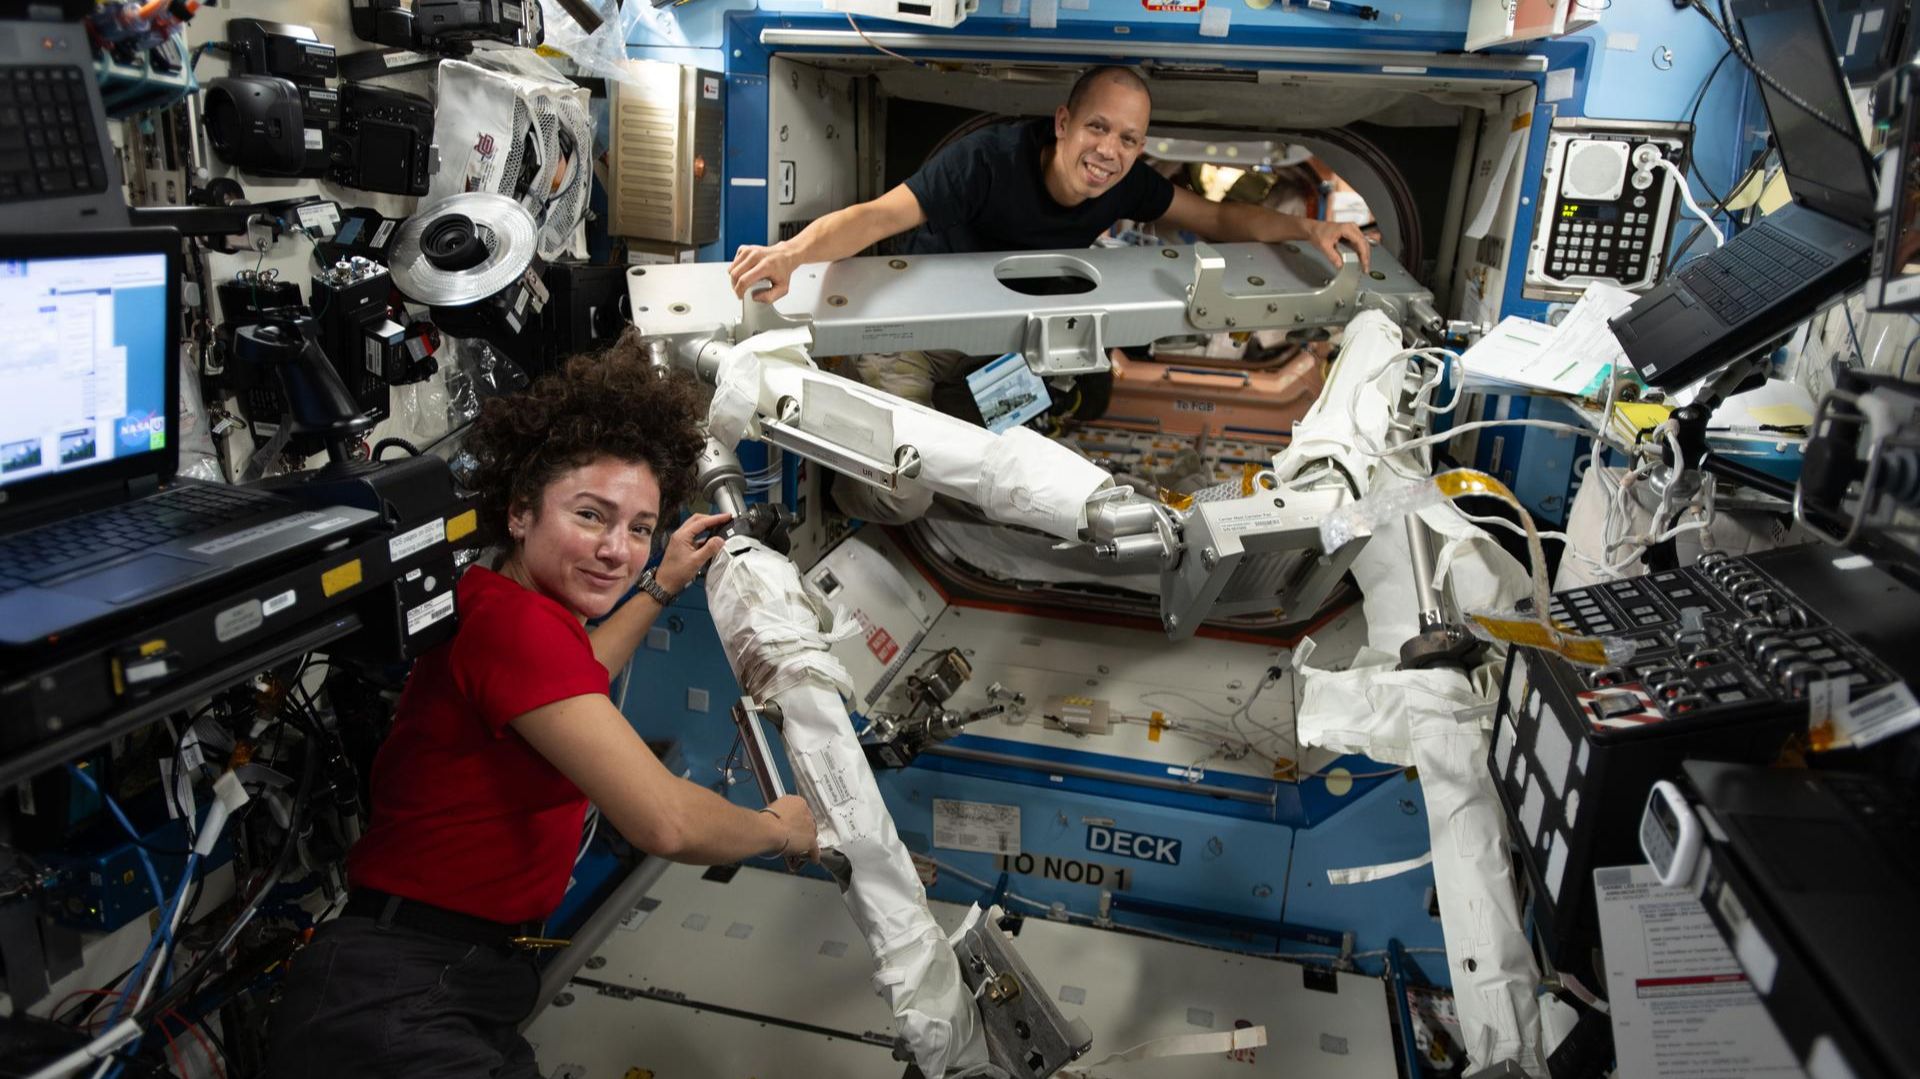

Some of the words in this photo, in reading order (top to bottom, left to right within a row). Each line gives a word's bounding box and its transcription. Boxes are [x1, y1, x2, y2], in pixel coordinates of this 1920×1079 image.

[1089, 827, 1177, 864] DECK
[1044, 856, 1104, 885] NOD
[1114, 869, 1125, 891] 1
